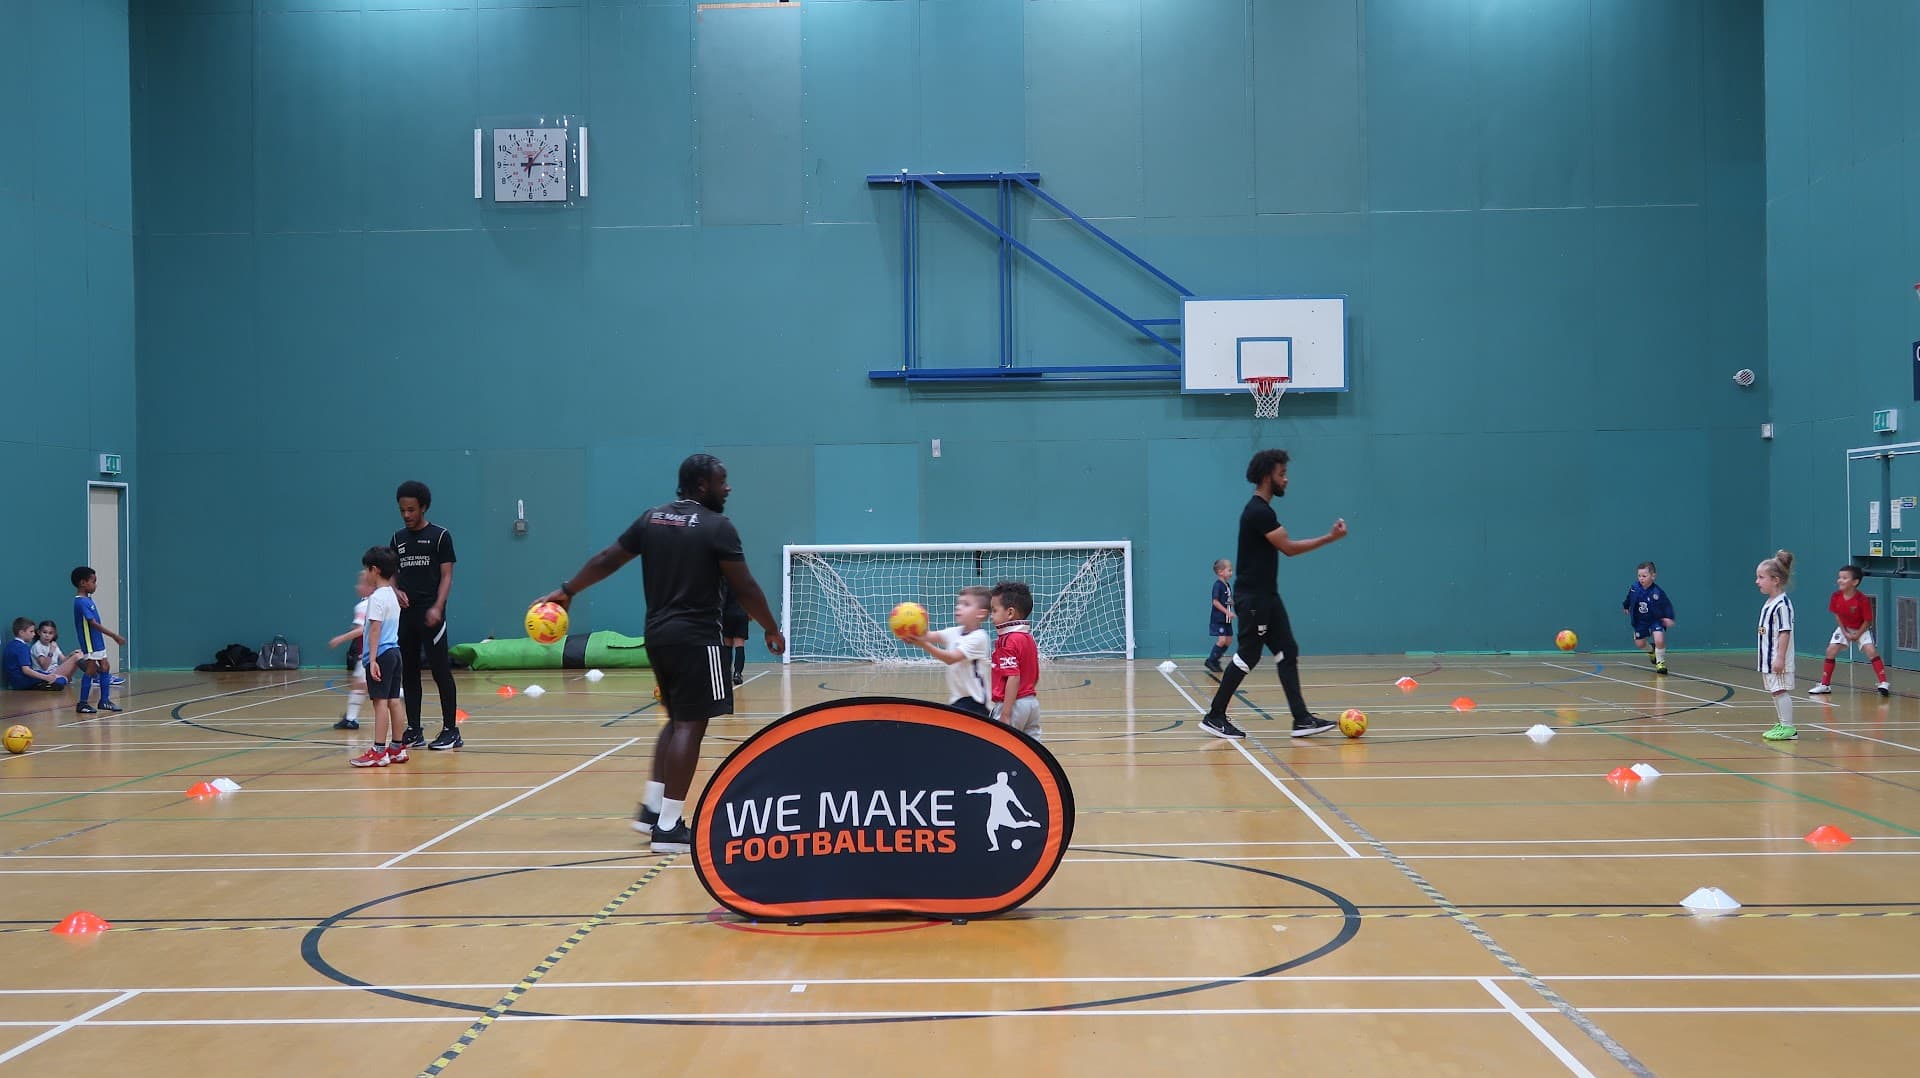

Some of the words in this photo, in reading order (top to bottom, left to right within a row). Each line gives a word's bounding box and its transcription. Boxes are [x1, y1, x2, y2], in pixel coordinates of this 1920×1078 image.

[554, 144, 559, 152] 2
[725, 794, 801, 838] WE
[818, 790, 956, 829] MAKE
[724, 829, 957, 865] FOOTBALLERS
